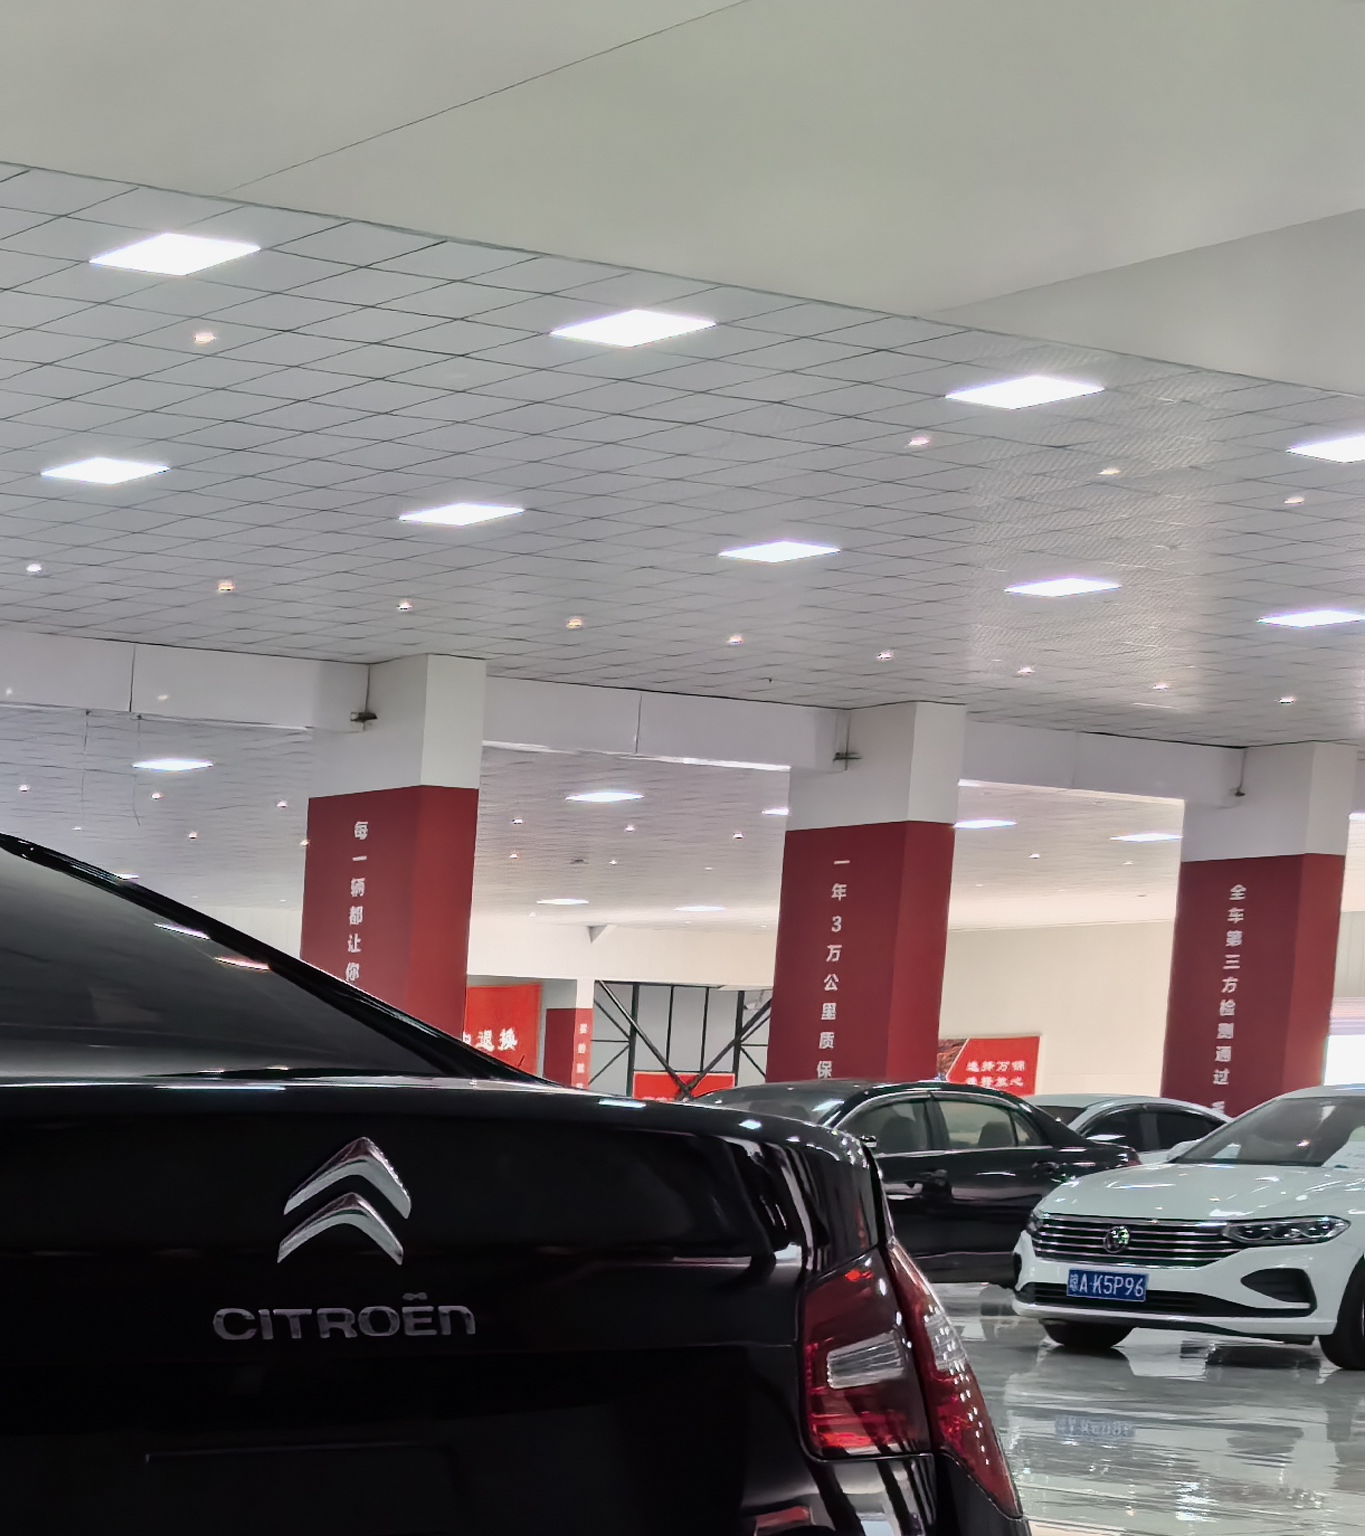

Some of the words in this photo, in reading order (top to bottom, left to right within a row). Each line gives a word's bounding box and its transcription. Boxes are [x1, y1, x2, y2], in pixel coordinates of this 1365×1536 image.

[345, 820, 368, 982] 每一辆都让你
[816, 860, 850, 1079] 一年3万公里质保
[1212, 883, 1246, 1085] 全车第三方检测通过
